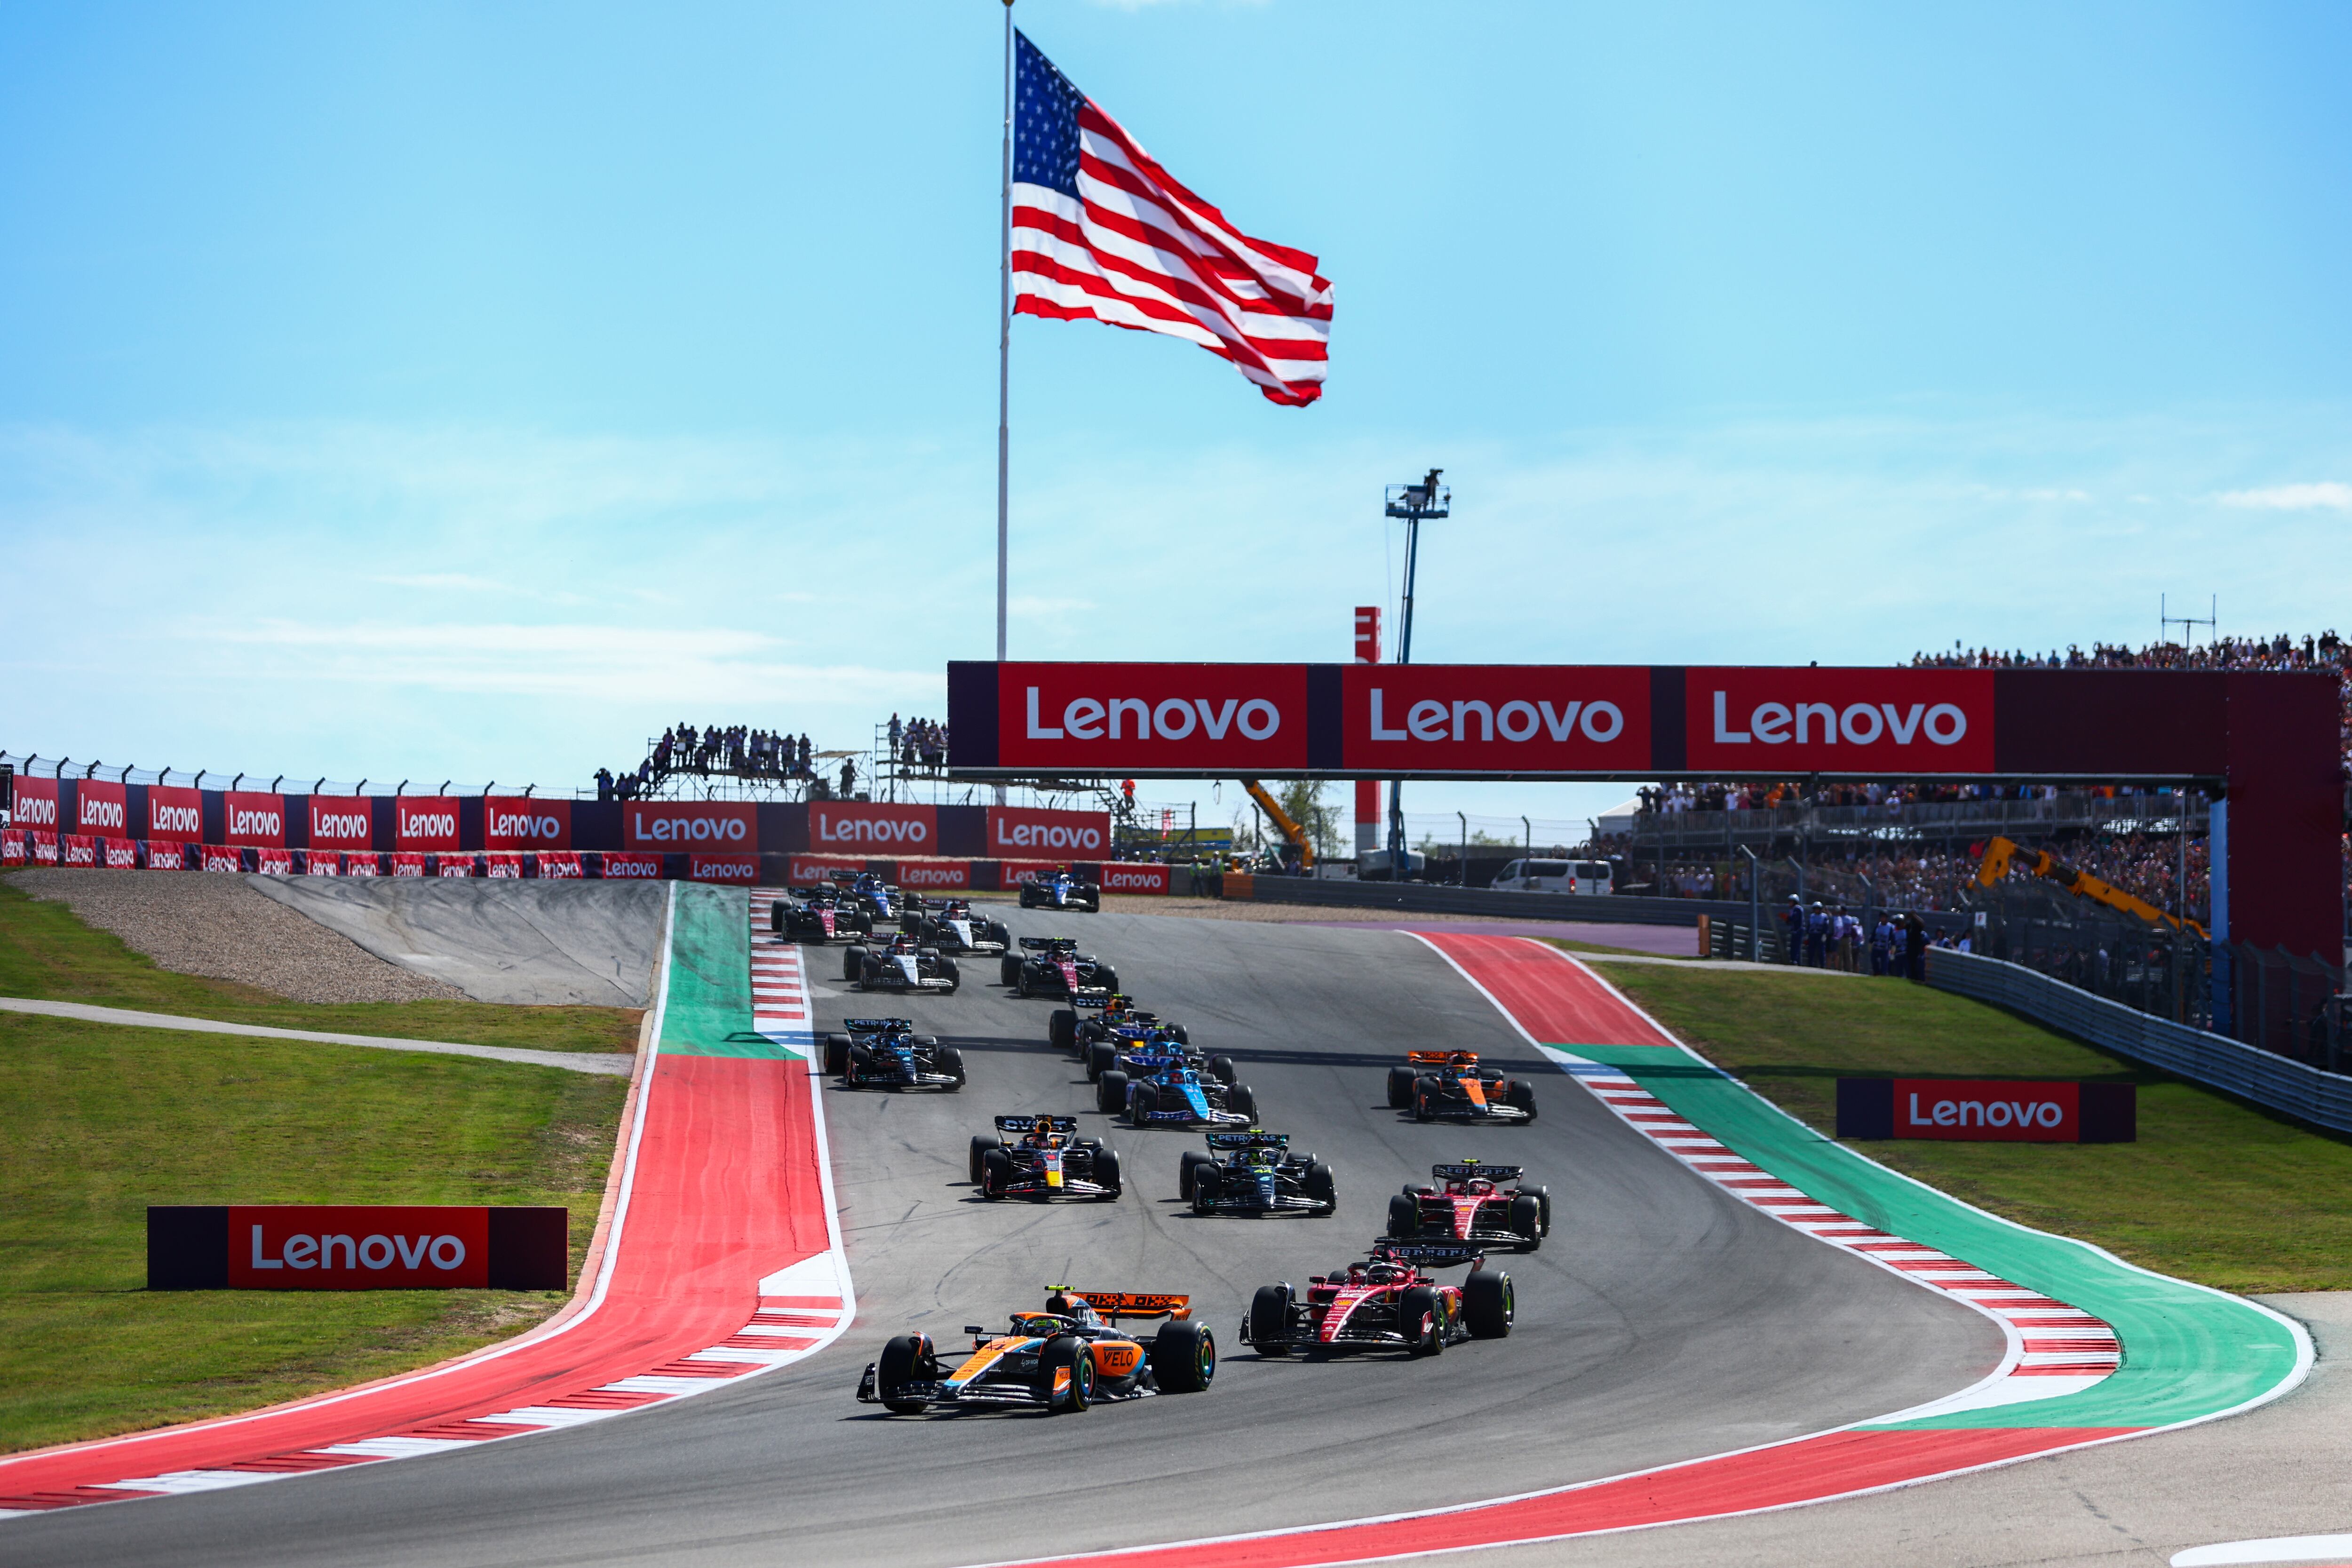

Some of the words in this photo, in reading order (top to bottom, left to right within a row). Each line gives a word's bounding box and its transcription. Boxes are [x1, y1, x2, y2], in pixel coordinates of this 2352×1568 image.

[1027, 687, 1279, 740] Lenovo
[1371, 689, 1623, 742] Lenovo
[1714, 691, 1966, 745] Lenovo
[15, 790, 55, 824] Lenovo
[81, 793, 122, 828] Lenovo
[153, 799, 198, 832] Lenovo
[230, 804, 279, 836] Lenovo
[314, 807, 366, 838] Lenovo
[402, 808, 454, 837] Lenovo
[490, 808, 560, 838] Lenovo
[636, 813, 746, 840] Lenovo
[820, 814, 926, 841] Lenovo
[998, 818, 1100, 848] Lenovo
[66, 843, 93, 862] Lenovo
[107, 845, 134, 865] Lenovo
[150, 849, 181, 869] Lenovo
[203, 853, 237, 872] Lenovo
[260, 856, 289, 875] Lenovo
[308, 859, 336, 876] Lenovo
[488, 860, 519, 878] Lenovo
[539, 860, 579, 878] Lenovo
[605, 859, 656, 876] Lenovo
[694, 860, 753, 877] Lenovo
[901, 867, 963, 883] Lenovo
[1104, 870, 1161, 887] Lenovo
[1910, 1093, 2062, 1127] Lenovo
[1446, 1166, 1509, 1175] Ferari
[253, 1225, 465, 1269] Lenovo
[1134, 1296, 1172, 1306] OKX
[1104, 1351, 1133, 1366] VELO
